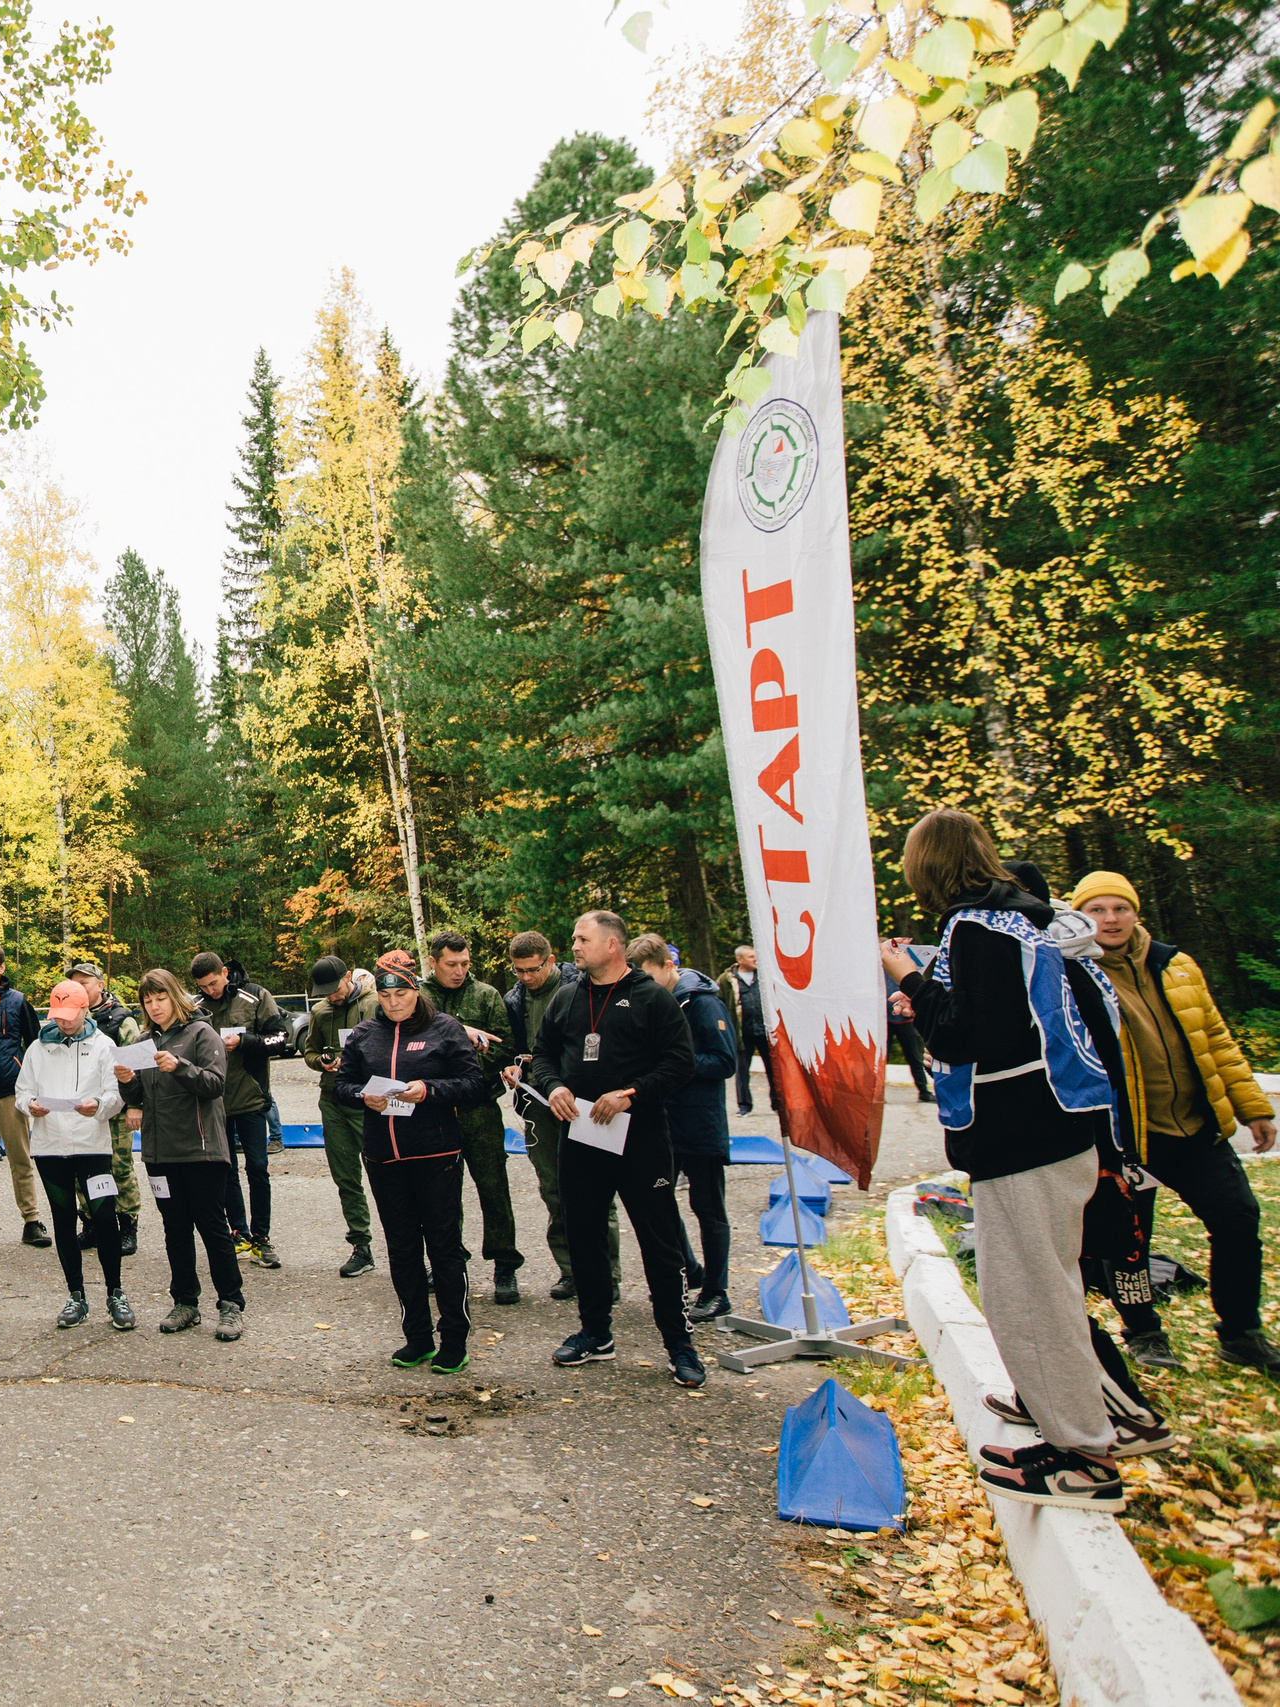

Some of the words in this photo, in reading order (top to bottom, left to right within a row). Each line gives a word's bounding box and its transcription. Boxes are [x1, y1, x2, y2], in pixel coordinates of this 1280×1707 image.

[742, 568, 816, 991] СТАРТ
[406, 1041, 426, 1052] RUN
[389, 1099, 405, 1109] 402
[96, 1181, 110, 1191] 417
